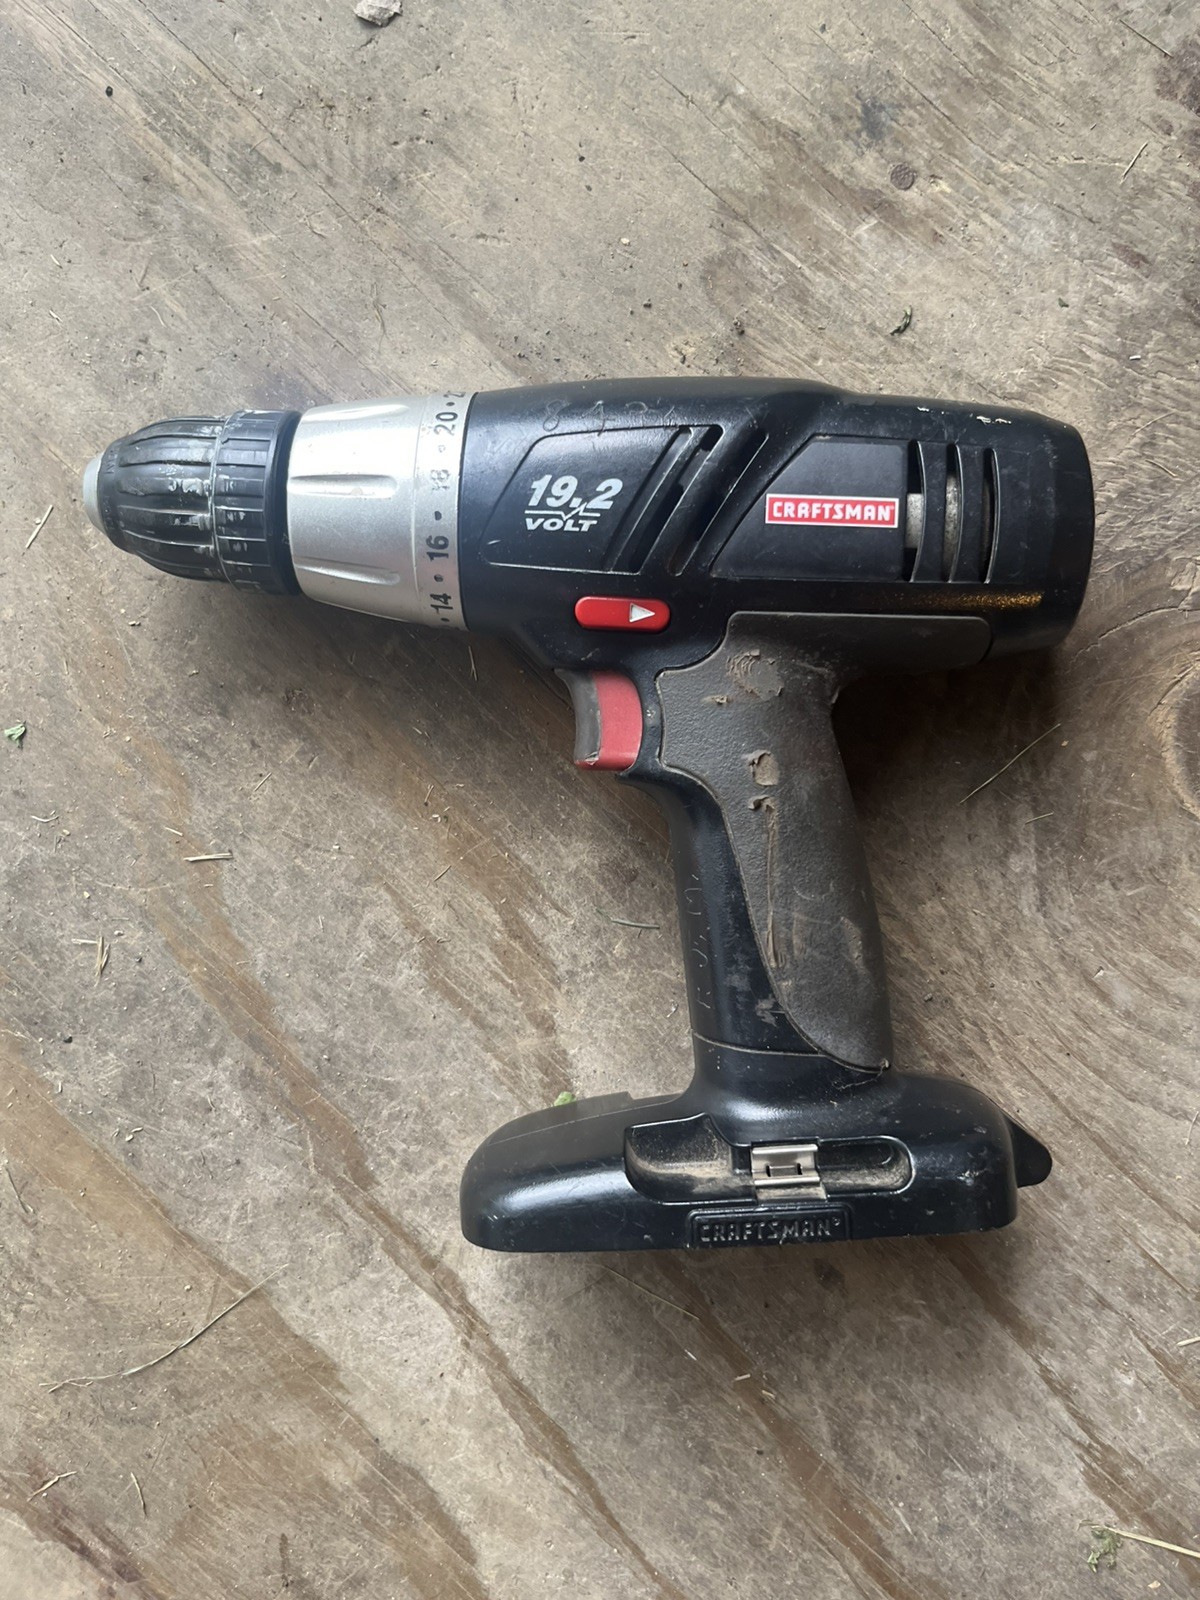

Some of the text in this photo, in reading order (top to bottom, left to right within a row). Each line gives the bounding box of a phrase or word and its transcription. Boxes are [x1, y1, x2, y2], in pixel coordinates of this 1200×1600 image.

[433, 411, 458, 436] 20
[528, 474, 623, 510] 19.2
[772, 501, 891, 521] CRAFTSMAN
[525, 517, 597, 532] VOLT
[425, 535, 449, 562] 16
[430, 593, 453, 614] 14
[700, 1220, 831, 1243] CRAFTSMAN
